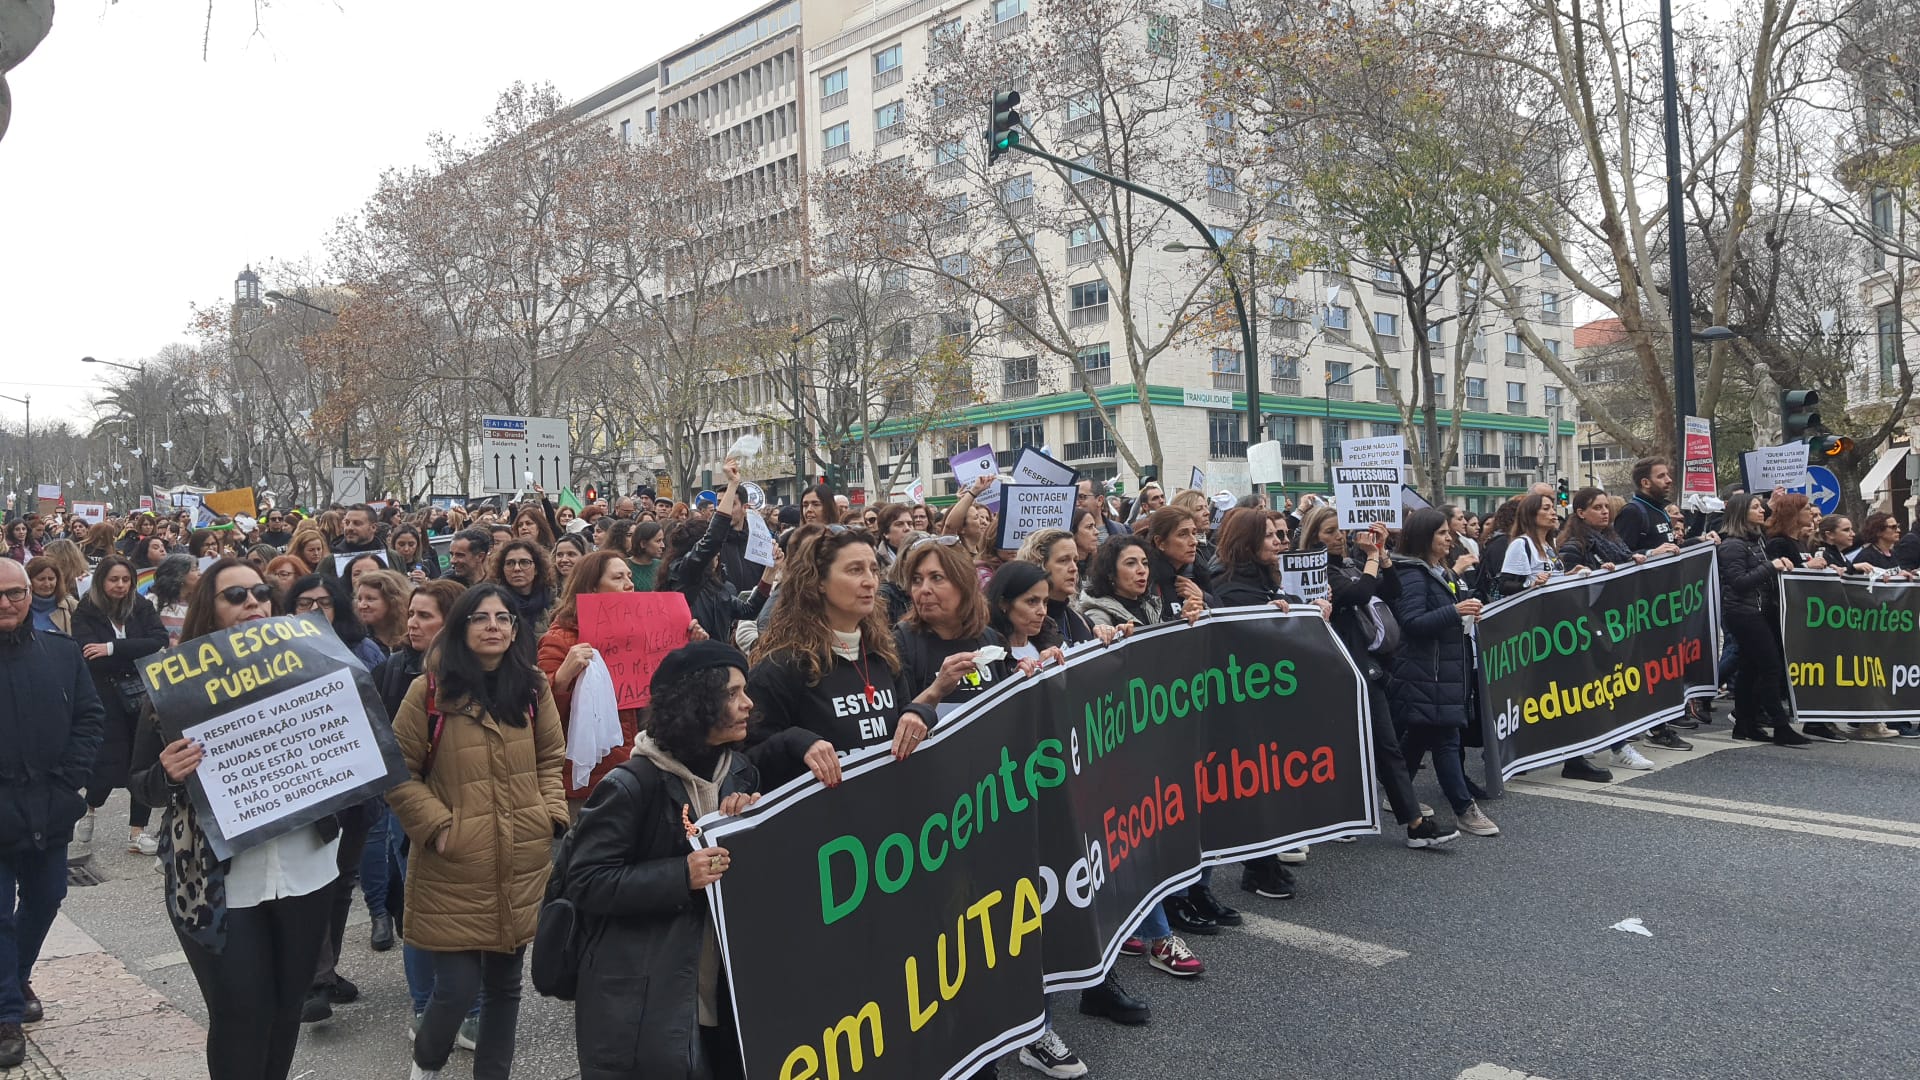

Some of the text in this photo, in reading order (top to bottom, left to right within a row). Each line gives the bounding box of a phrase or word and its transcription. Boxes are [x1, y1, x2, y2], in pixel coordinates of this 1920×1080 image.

[1185, 392, 1231, 404] TRANQUILIDADE
[1022, 466, 1057, 485] RESPEIT
[1340, 469, 1396, 481] PROFESSORES
[1018, 493, 1068, 502] CONTAGEM
[1353, 485, 1390, 497] A LUTAR
[1355, 499, 1377, 507] TAMBÉM
[1019, 518, 1063, 527] DO TEMPO
[1021, 506, 1063, 515] INTEGRAL
[1348, 510, 1396, 523] A ENSINAR
[1013, 531, 1027, 539] DE
[1301, 572, 1310, 586] A
[598, 601, 670, 624] ATACAR
[145, 619, 321, 691] PELA ESCOLA
[1482, 616, 1592, 685] VIATODOS
[1789, 662, 1825, 687] em
[1836, 655, 1887, 688] LUTA
[832, 689, 894, 717] ESTOU
[1523, 663, 1641, 724] educação
[204, 681, 344, 742] RESPEITO E VALORIZAÇÃO
[1070, 726, 1081, 775] e
[1085, 691, 1126, 765] Não
[1129, 653, 1298, 735] Docentes
[211, 703, 333, 757] REMUNERAÇÃO JUSTA
[859, 716, 888, 740] EM
[218, 715, 350, 772] AJUDAS DE CUSTO PARA
[222, 731, 346, 784] OS QUE ESTÃO LONGE
[228, 740, 361, 797] MAIS PESSOAL DOCENTE
[233, 768, 324, 809] E NÃO DOCENTE
[239, 769, 355, 823] MENOS BUROCRACIA
[779, 1001, 884, 1080] em
[905, 877, 1042, 1032] LUTA
[1103, 775, 1185, 873] Escola
